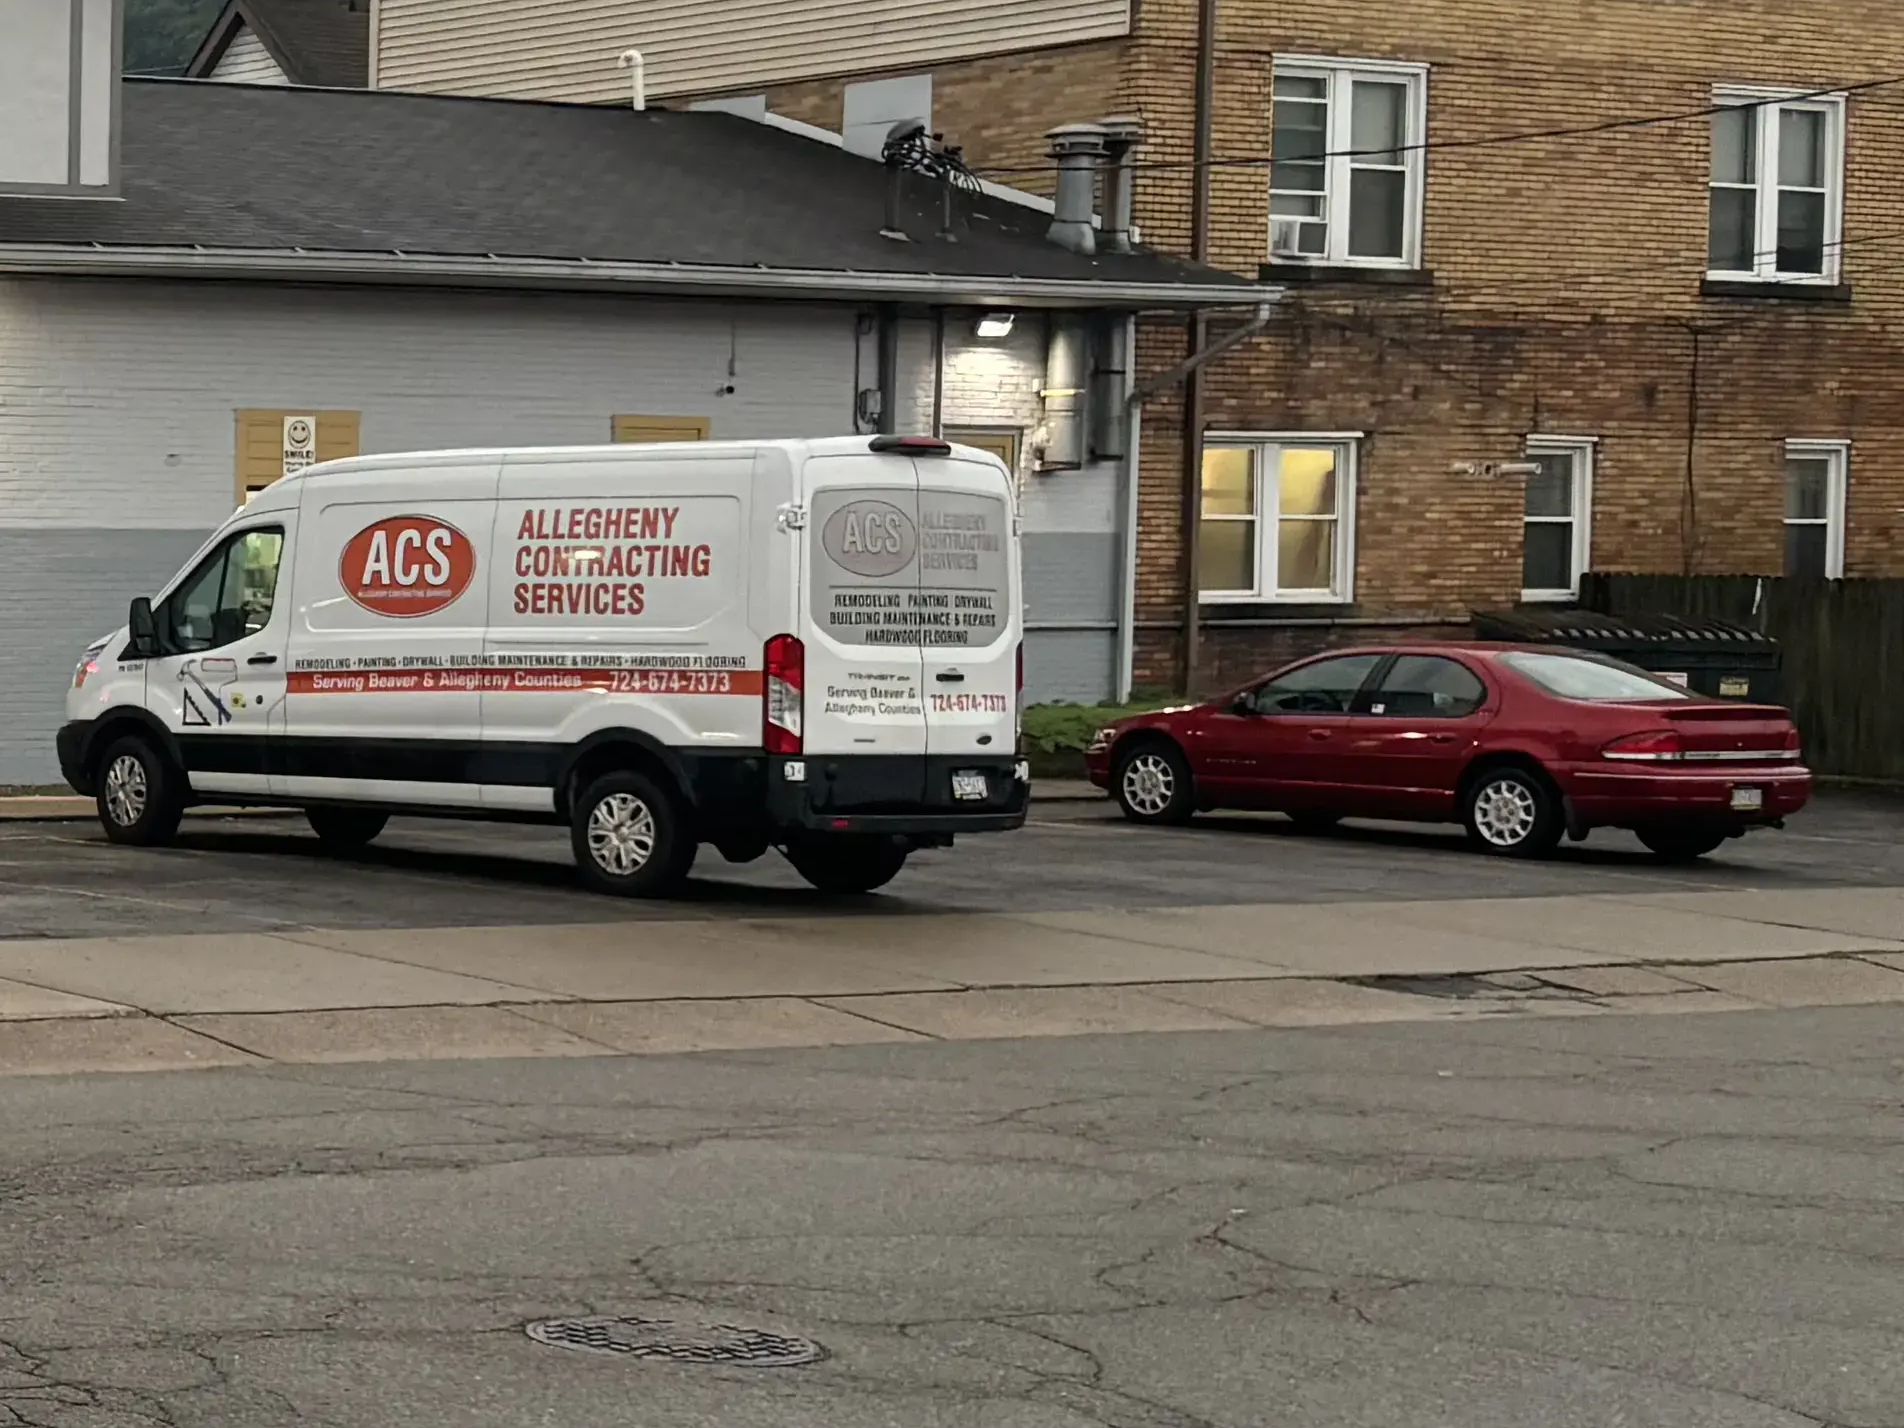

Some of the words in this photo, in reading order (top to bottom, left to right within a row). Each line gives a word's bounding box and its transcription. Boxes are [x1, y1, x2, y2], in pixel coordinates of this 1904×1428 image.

[517, 507, 680, 540] ALLEGHENY
[841, 510, 901, 555] ACS
[361, 528, 452, 586] ACS
[515, 544, 712, 578] CONTRACTING
[513, 582, 645, 615] SERVICES
[834, 594, 900, 608] REMODELING
[907, 594, 949, 609] PAINTING
[830, 612, 880, 625] BUILDING
[922, 630, 968, 645] FLOORING
[295, 658, 350, 669] REMODELING
[357, 657, 396, 668] PAINTING
[402, 656, 443, 667] DRYWALL
[450, 655, 495, 667] BUILDING
[497, 655, 567, 666] MAINTENANCE
[630, 656, 690, 668] HARDWOOD
[312, 673, 364, 691] Serving
[368, 673, 418, 689] Beaver
[422, 672, 435, 688] &
[439, 672, 511, 691] Allegheny
[514, 671, 582, 688] Counties
[609, 671, 731, 692] 724-674-7373
[827, 686, 867, 700] Serving
[930, 694, 1007, 713] 724-674-7373
